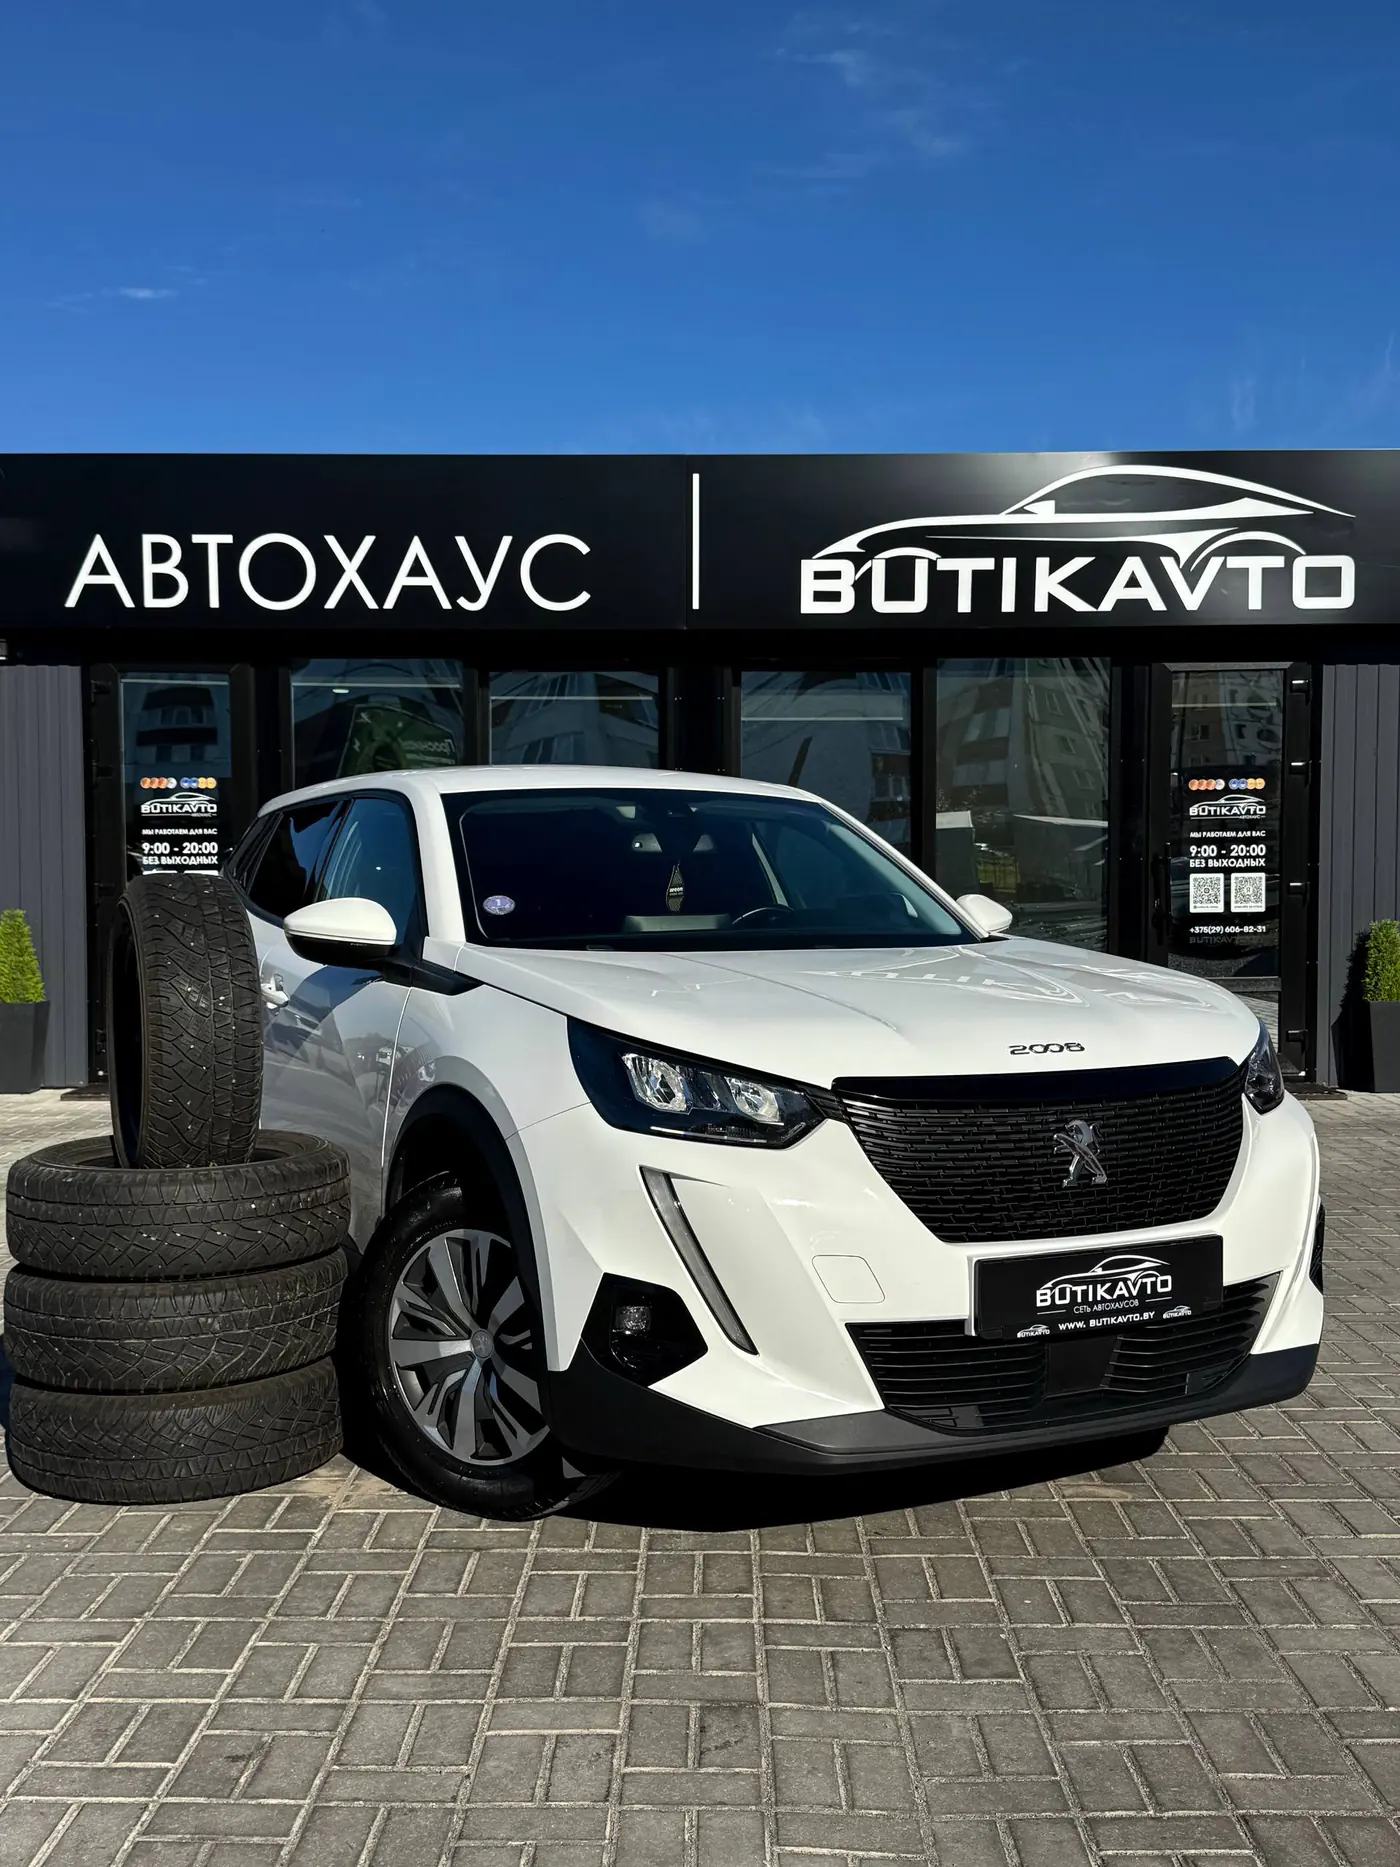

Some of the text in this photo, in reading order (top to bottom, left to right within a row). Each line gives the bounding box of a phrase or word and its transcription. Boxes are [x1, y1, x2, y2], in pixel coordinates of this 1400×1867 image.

[64, 533, 592, 612] АВТОХАУС
[800, 554, 1355, 614] BUTIKAVTO
[141, 803, 217, 813] BUTIKAVTO
[1189, 806, 1266, 816] BUTIKAVTO
[1236, 830, 1251, 838] ДЛЯ
[142, 842, 170, 854] 9:00
[182, 842, 218, 854] 20:00
[1189, 845, 1217, 857] 9:00
[1230, 844, 1266, 856] 20:00
[142, 856, 218, 865] БЕЗ ВЫХОДНЫХ
[1189, 858, 1266, 868] БЕЗ ВЫХОДНЫХ
[1189, 925, 1267, 934] +375(29) 606-82-31
[1009, 1042, 1085, 1055] 2008
[1036, 1275, 1172, 1307] BUTIKAVTO
[1073, 1299, 1139, 1314] СЕТЬ АВТОХАУСОВ
[1089, 1311, 1155, 1327] BUTIKAVTO.BY
